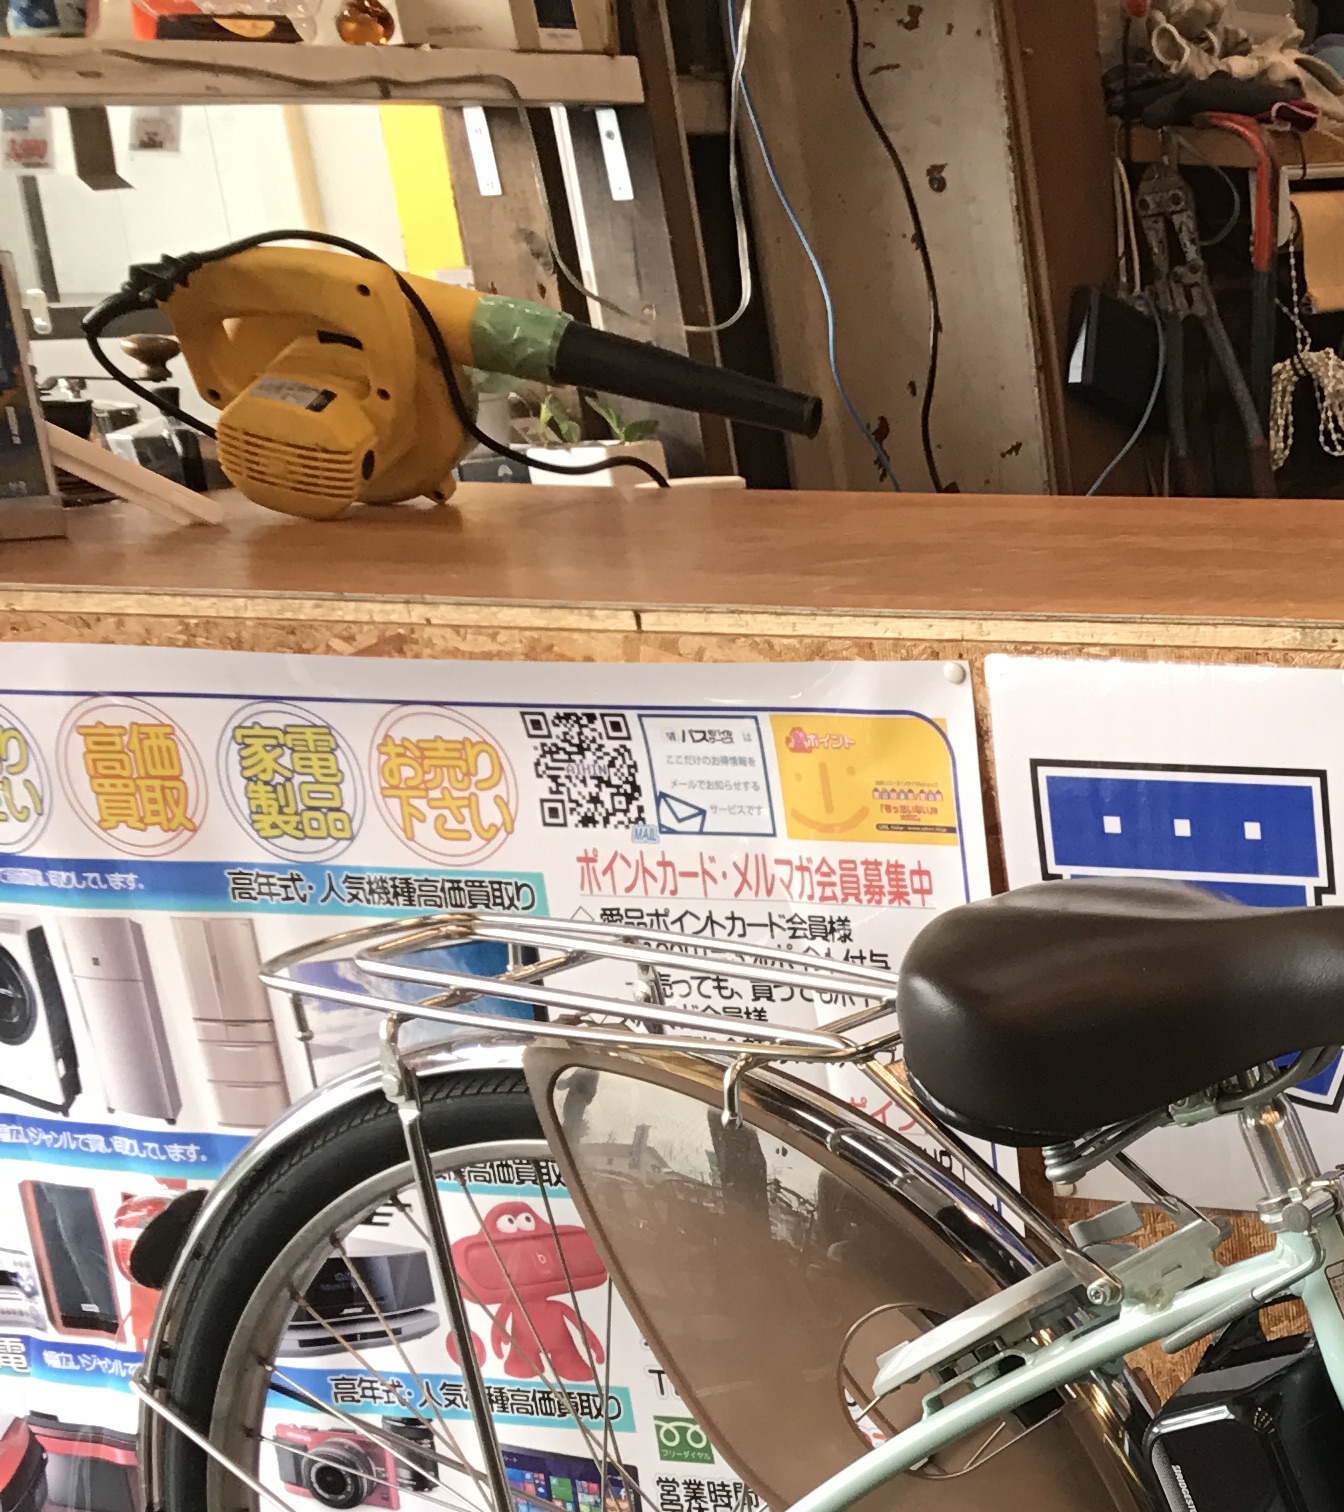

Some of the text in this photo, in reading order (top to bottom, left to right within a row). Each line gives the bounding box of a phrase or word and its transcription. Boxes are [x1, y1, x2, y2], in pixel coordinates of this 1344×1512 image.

[77, 721, 184, 778] 高価
[233, 722, 344, 783] 家電
[376, 733, 505, 792] お売り
[91, 776, 198, 833] 買取
[246, 780, 354, 841] 製品
[379, 785, 518, 845] 下さい
[225, 868, 539, 914] 高年式・人気機種高価買取り
[576, 848, 936, 908] ポイントカード・メルマガ会員募集中
[329, 1375, 622, 1422] 高年式・人気種高価買取り
[661, 1448, 712, 1461] フリーダイヤル
